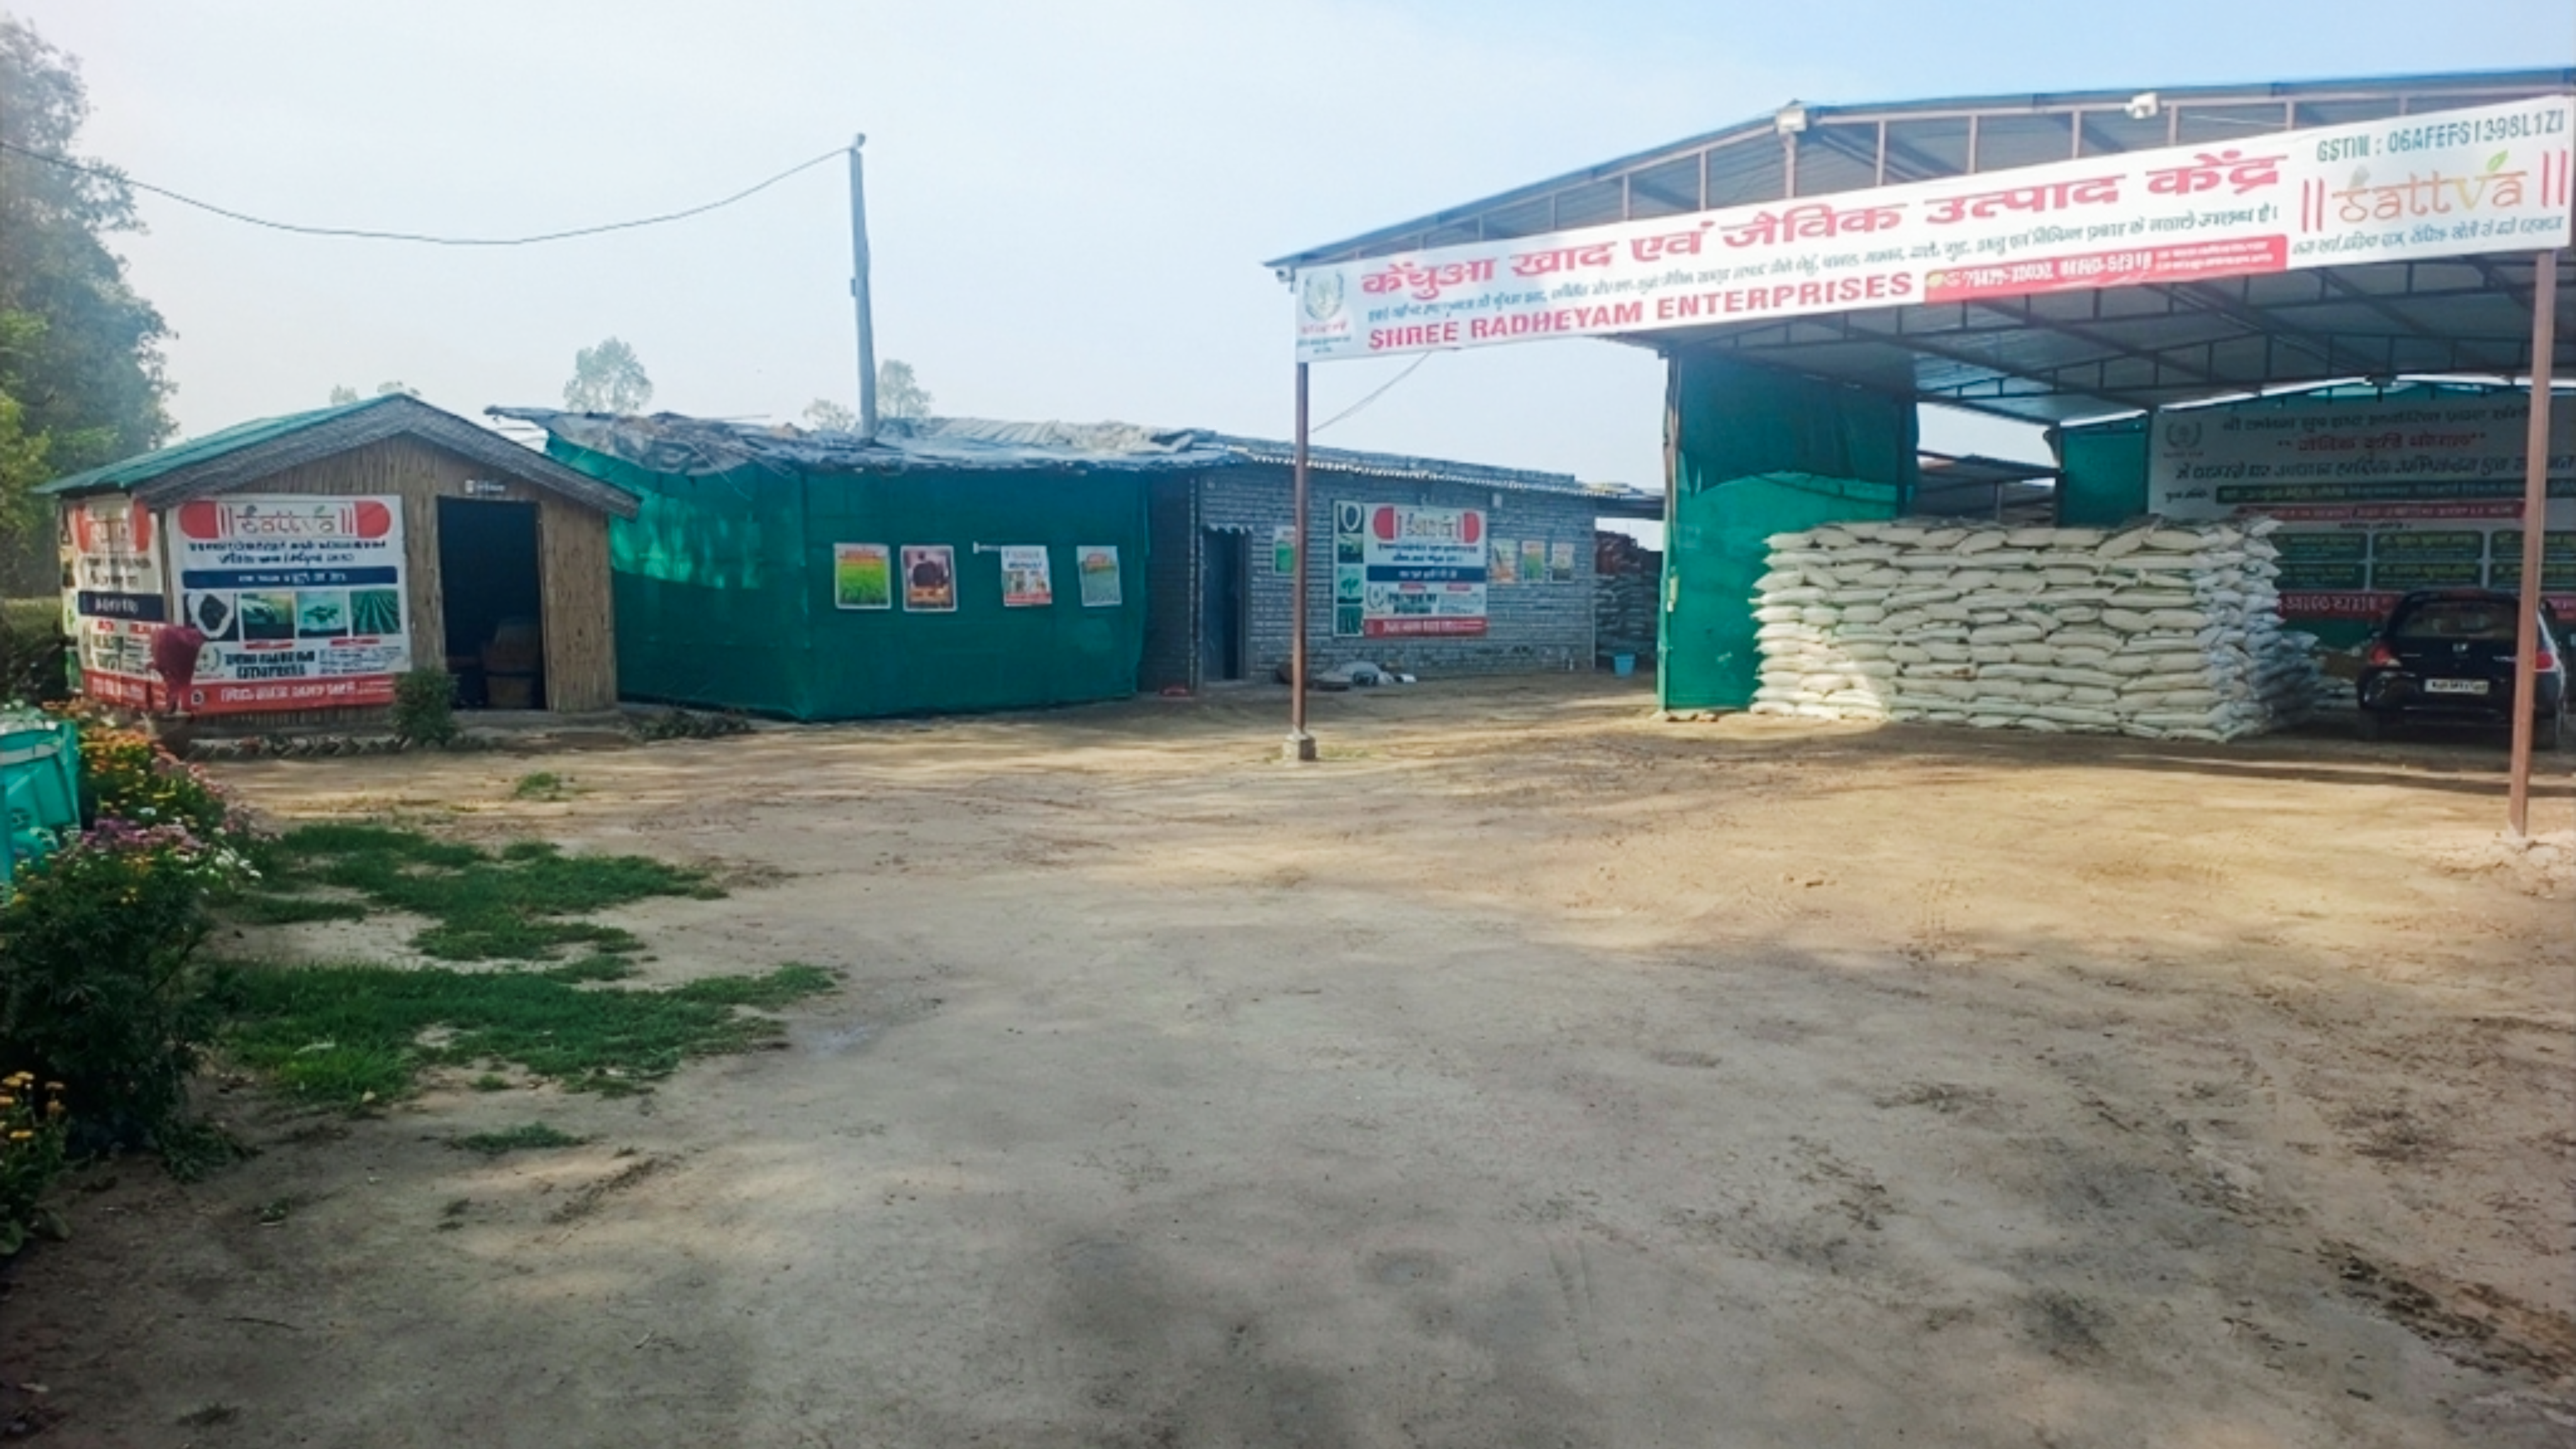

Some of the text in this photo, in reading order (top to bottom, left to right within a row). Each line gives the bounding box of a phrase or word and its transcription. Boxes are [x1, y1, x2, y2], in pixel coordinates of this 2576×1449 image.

[2316, 135, 2370, 163] GSTIN
[1511, 241, 1617, 277] खाद
[1630, 221, 1715, 262] एवं
[1721, 204, 1907, 247] जैविक
[1924, 174, 2127, 224] उत्पाद
[2145, 150, 2289, 195] केंद्र
[1368, 321, 1460, 350] SHREE
[1471, 301, 1643, 339] RADHEYAM
[1657, 272, 1913, 320] ENTERPRISES
